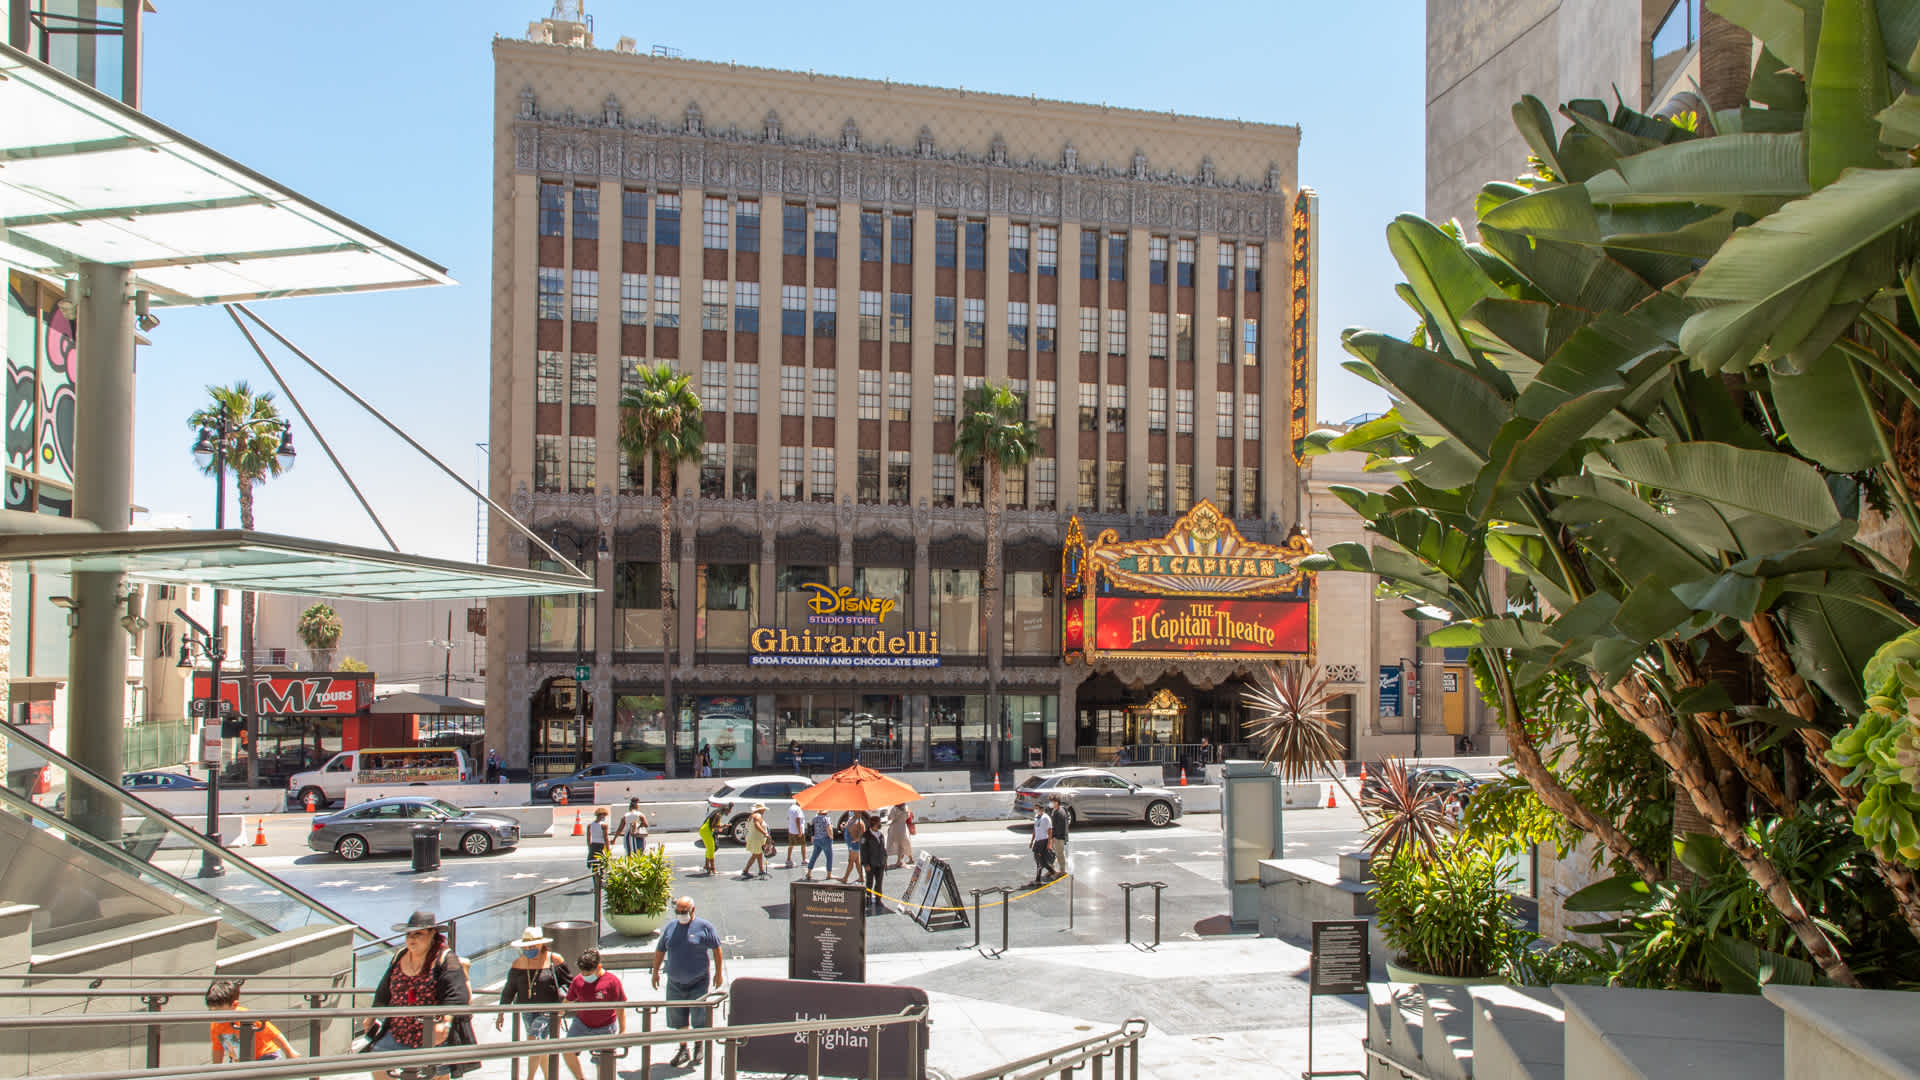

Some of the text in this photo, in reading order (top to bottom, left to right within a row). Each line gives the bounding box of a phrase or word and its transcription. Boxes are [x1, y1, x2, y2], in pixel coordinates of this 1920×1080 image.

[1293, 236, 1305, 440] CAPITAN
[1136, 556, 1275, 576] EL CAPITAN
[801, 582, 895, 624] Disney
[1190, 603, 1215, 618] THE
[809, 615, 877, 625] STUDIO STORE
[1132, 611, 1275, 647] El Capitan Theatre
[751, 627, 940, 655] Ghirardelli
[1178, 638, 1230, 646] HOLLYWOOD
[752, 656, 939, 667] SODA FOUNTAIN AND CHOCOLATE SHOP
[219, 675, 338, 717] TMZ
[316, 690, 353, 703] TOURS
[794, 1029, 870, 1050] &ighlan
